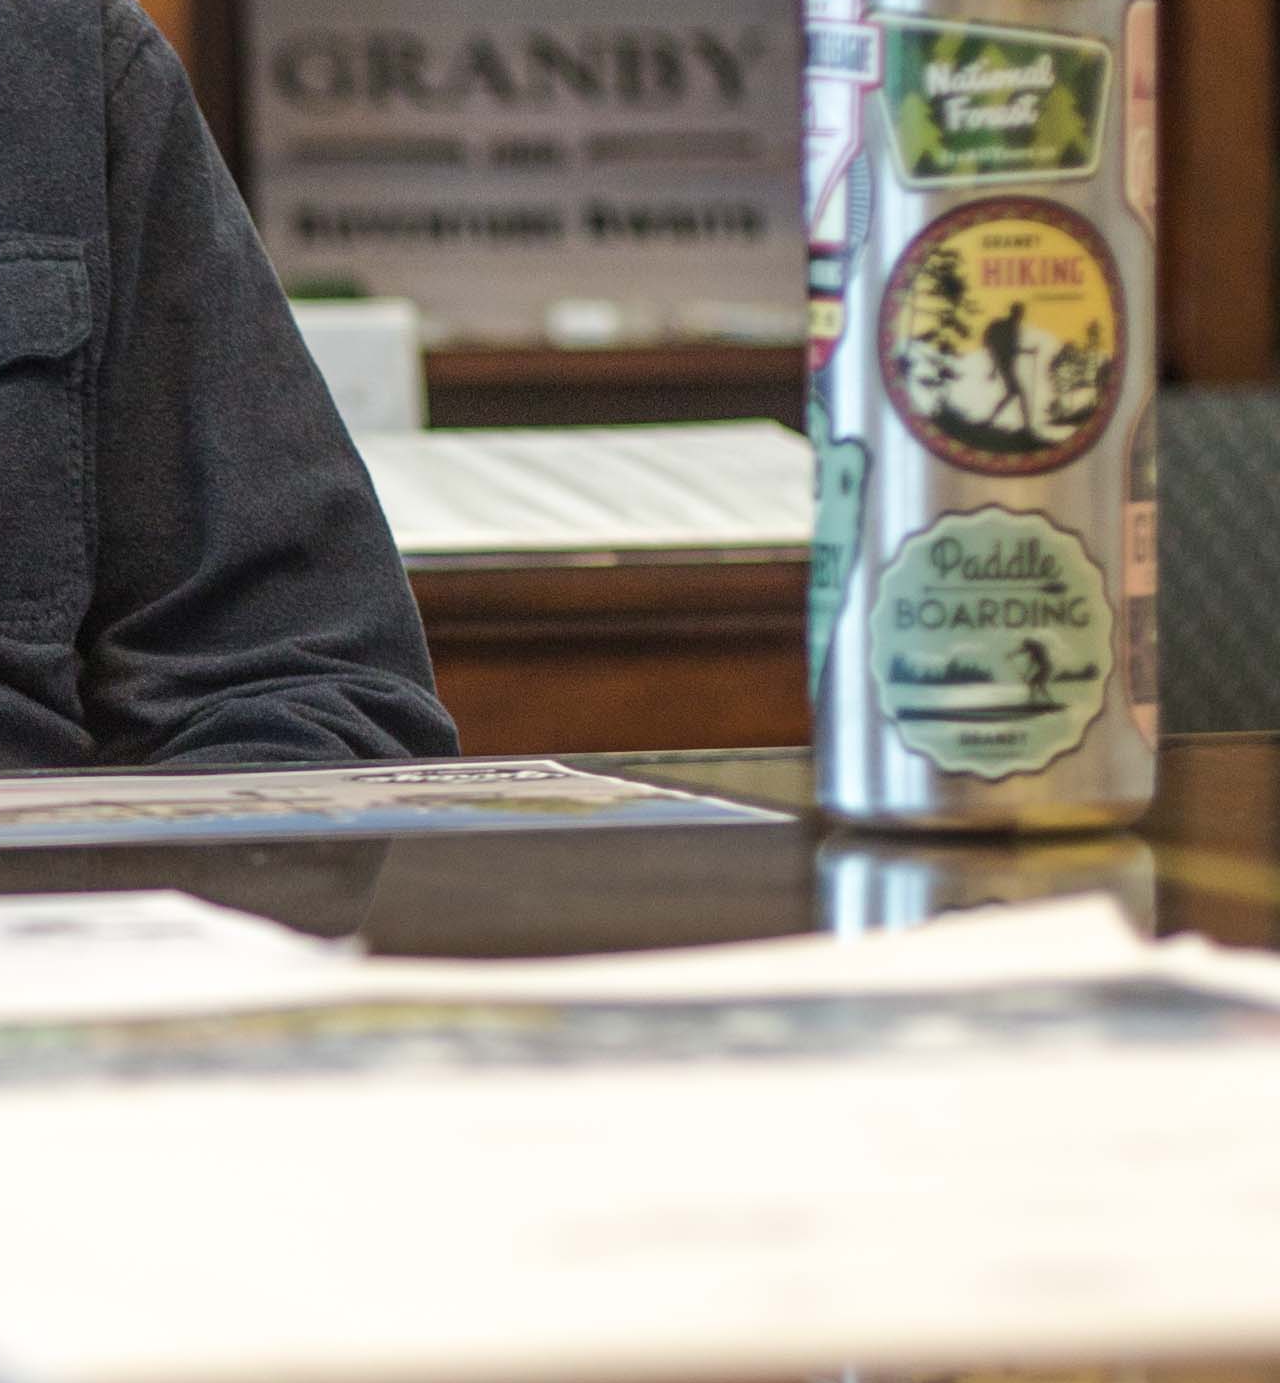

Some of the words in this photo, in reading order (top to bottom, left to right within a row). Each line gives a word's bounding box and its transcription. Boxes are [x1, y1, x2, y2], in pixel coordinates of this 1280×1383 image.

[274, 27, 766, 105] GRANBY
[924, 54, 1056, 96] National
[944, 94, 1040, 130] Forest
[980, 257, 1084, 287] HIKING
[930, 536, 1062, 580] Paddle
[894, 596, 1091, 630] BOARDING
